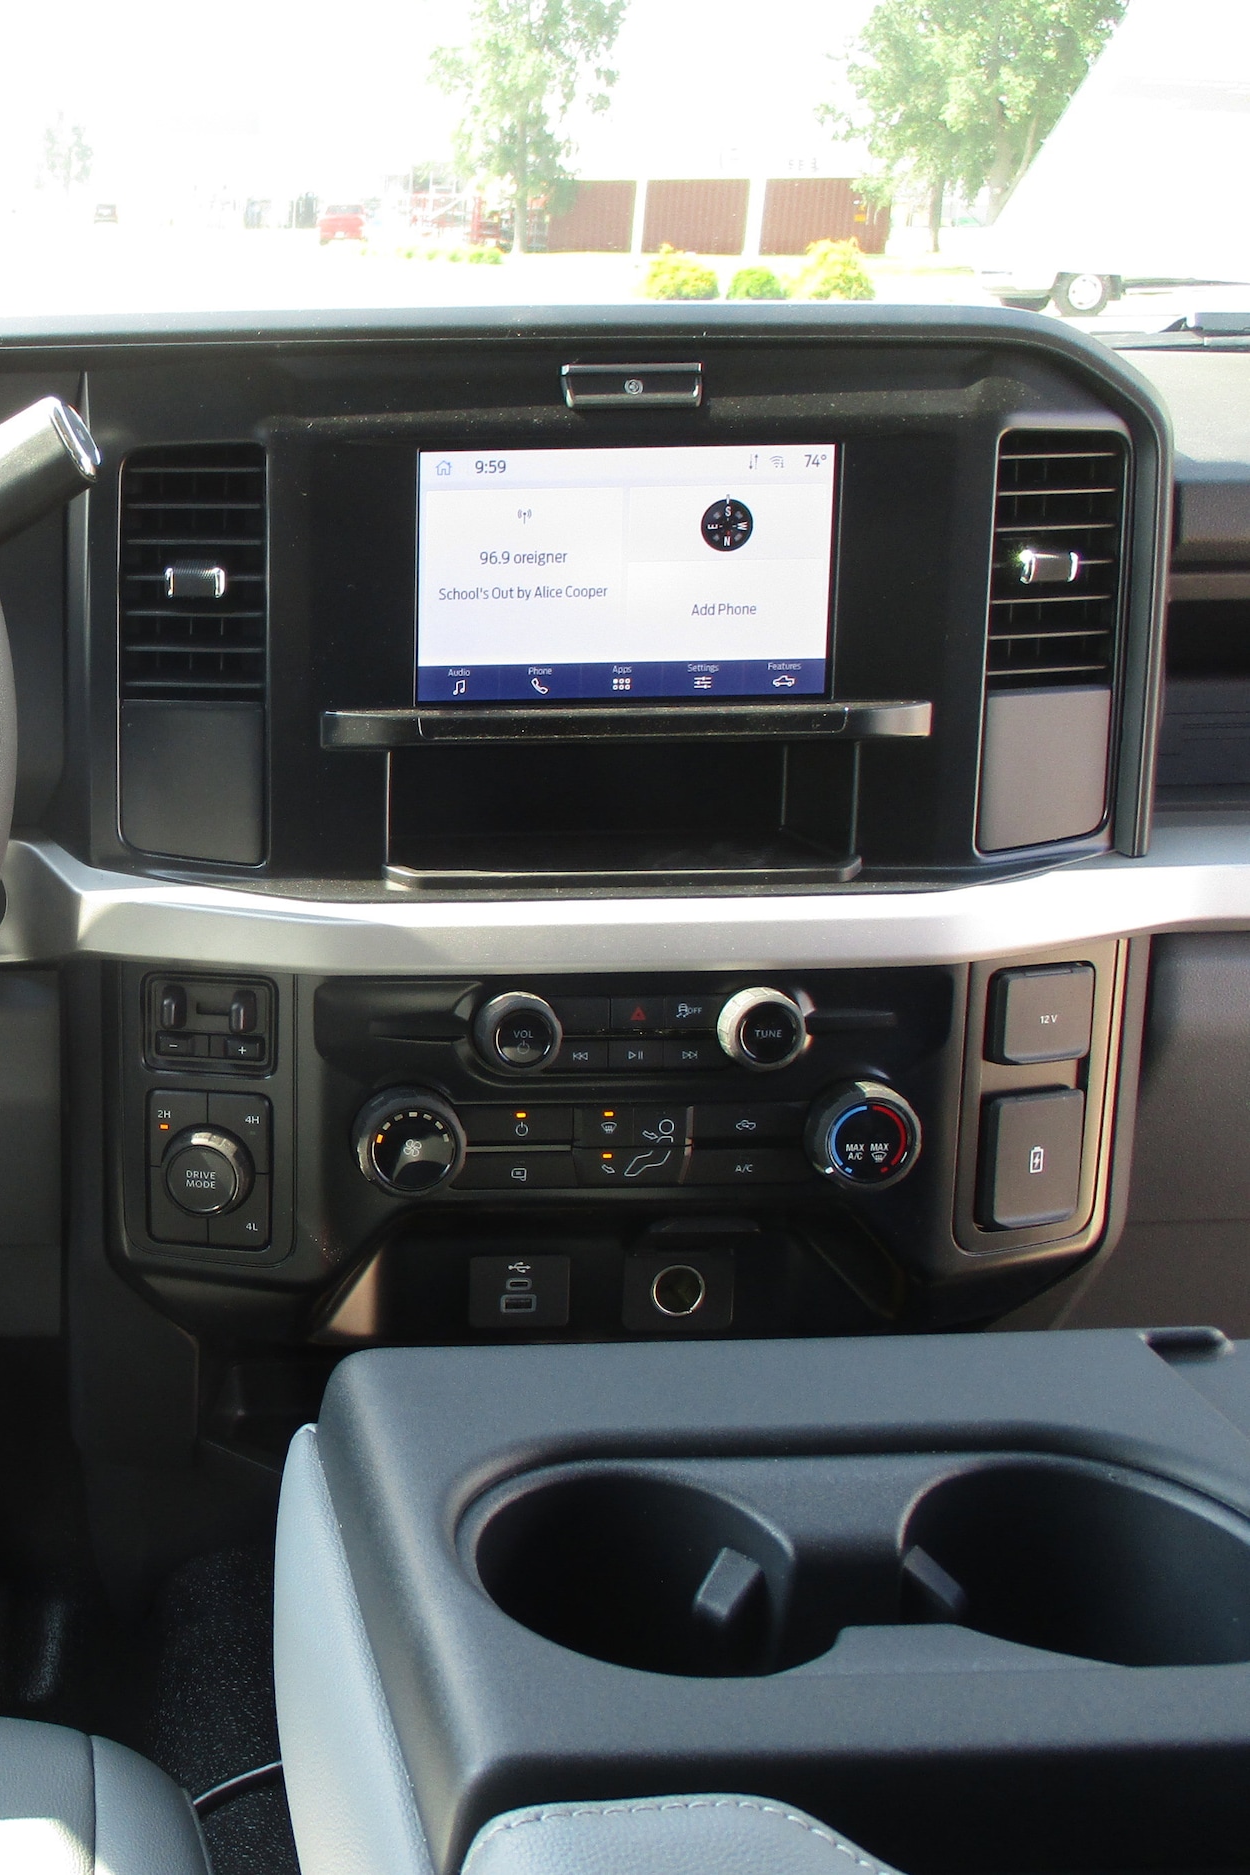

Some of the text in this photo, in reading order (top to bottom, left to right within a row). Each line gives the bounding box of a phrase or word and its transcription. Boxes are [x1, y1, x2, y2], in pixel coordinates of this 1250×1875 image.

[475, 460, 507, 474] 9:59
[479, 551, 568, 567] 96.9 oreigner
[438, 585, 608, 601] School's Out by Alice Cooper
[691, 603, 757, 616] Add Phone
[528, 666, 552, 675] Phone
[612, 665, 632, 675] Apps
[687, 663, 719, 674] Settings
[767, 662, 801, 671] Features
[448, 668, 471, 677] Audio
[688, 1006, 703, 1014] OFF
[1040, 1014, 1058, 1024] 12 V
[513, 1029, 534, 1039] VOL
[754, 1029, 783, 1038] TUNE
[157, 1109, 171, 1119] 2H
[244, 1115, 260, 1125] 4H
[845, 1143, 865, 1152] MAX
[870, 1143, 889, 1152] MAX
[847, 1151, 863, 1161] A/C
[735, 1164, 753, 1174] A/C
[186, 1169, 216, 1180] DRIVE
[186, 1179, 216, 1189] MODE
[245, 1222, 258, 1232] 4L
